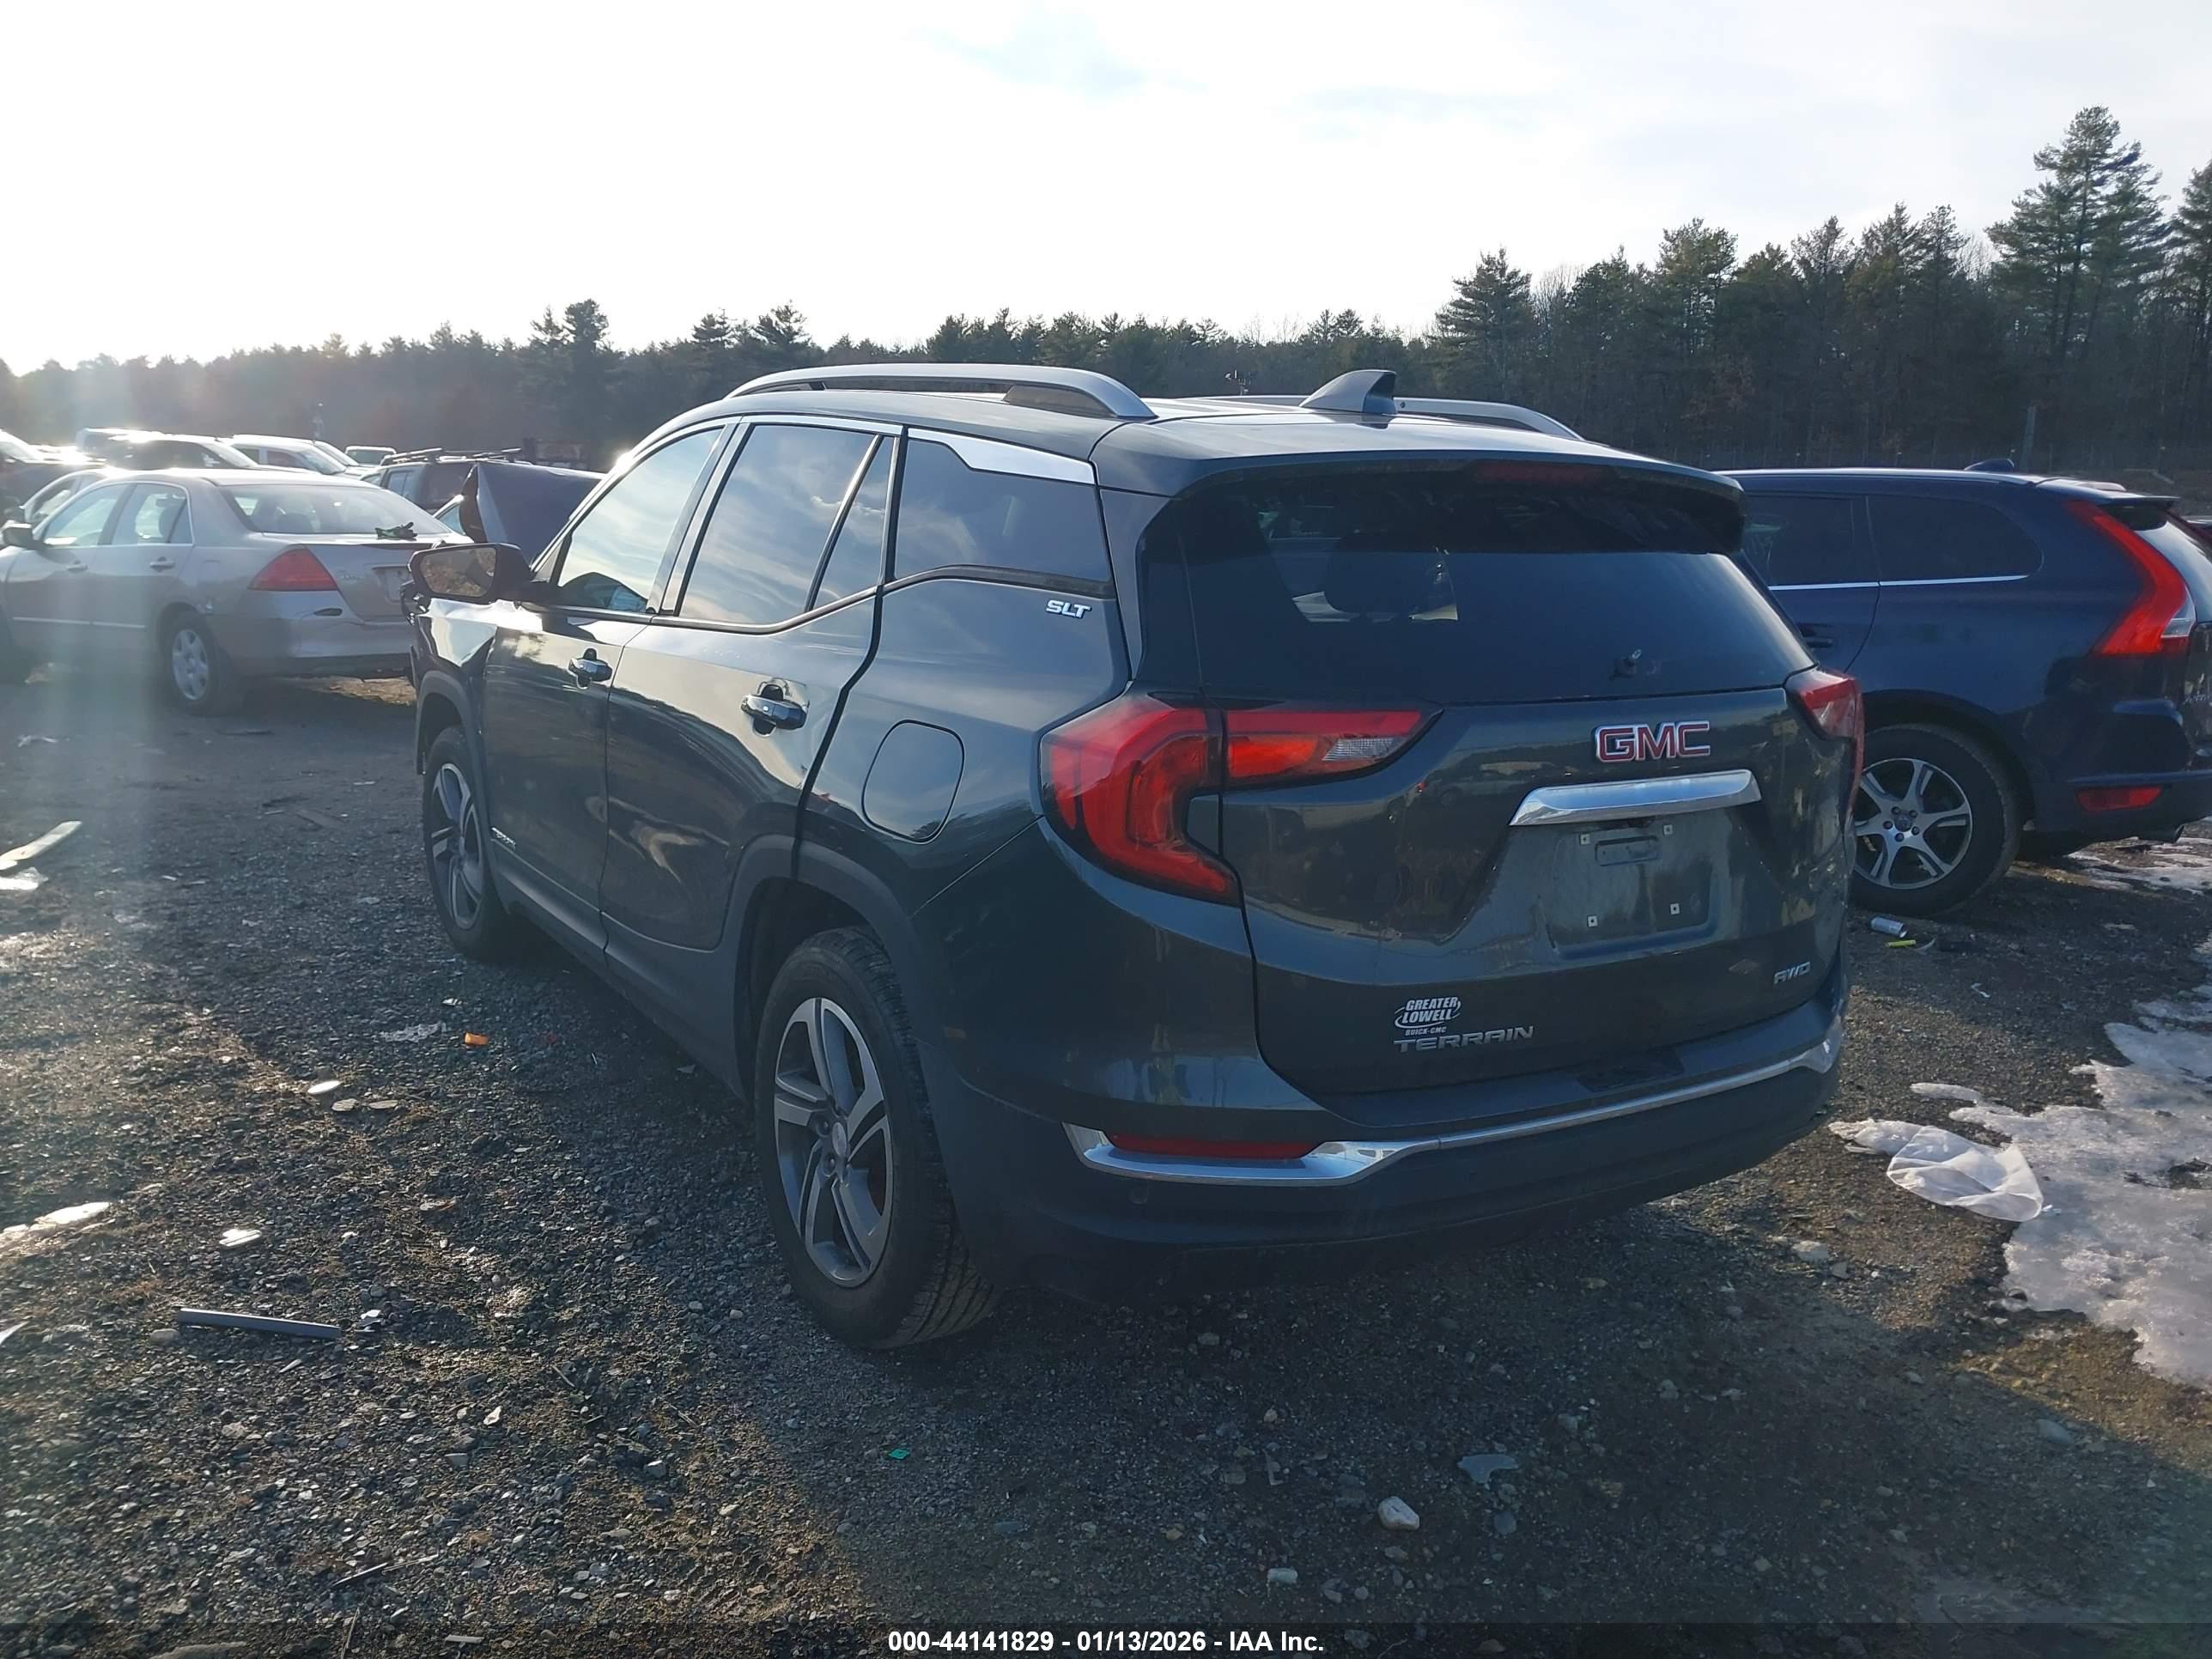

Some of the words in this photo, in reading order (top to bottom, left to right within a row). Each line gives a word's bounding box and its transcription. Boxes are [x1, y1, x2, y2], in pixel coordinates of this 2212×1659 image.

[1046, 599, 1091, 618] SLT
[1595, 720, 1711, 763] GMC
[1774, 962, 1810, 984] AWD
[1406, 997, 1459, 1011] GREATER
[1401, 1009, 1452, 1024] LOWELL
[1394, 1025, 1534, 1053] TERRAIN
